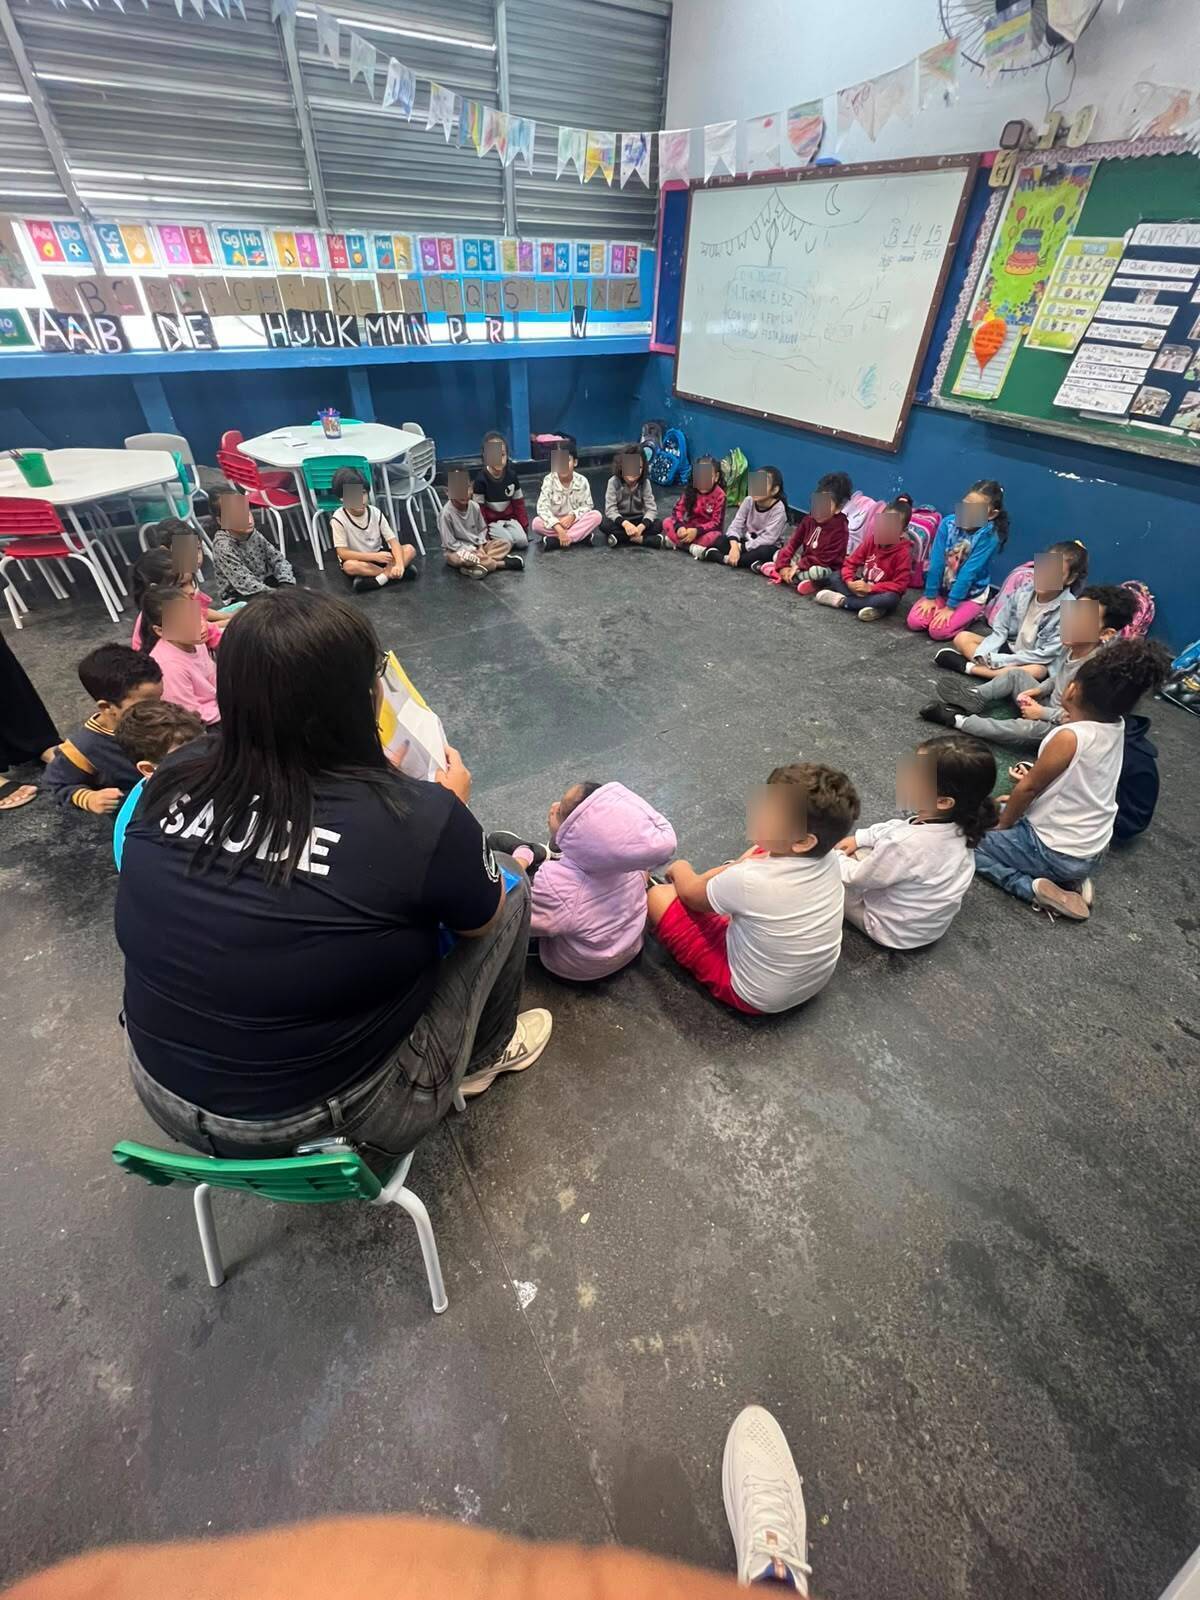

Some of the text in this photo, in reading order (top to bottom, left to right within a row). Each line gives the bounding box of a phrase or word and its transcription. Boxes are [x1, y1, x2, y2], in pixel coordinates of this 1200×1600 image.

[59, 224, 80, 240] Bb
[100, 227, 120, 241] Cc
[221, 232, 241, 249] Gg
[245, 232, 262, 247] Hh
[78, 280, 106, 313] B
[232, 281, 253, 311] G
[333, 282, 350, 311] K
[380, 280, 400, 304] M
[466, 284, 481, 307] Q
[502, 280, 520, 310] S
[554, 281, 569, 309] V
[625, 283, 638, 304] Z
[39, 308, 73, 350] A
[67, 316, 97, 350] A
[94, 317, 123, 353] B
[156, 313, 183, 352] D
[184, 315, 212, 349] E
[265, 312, 289, 347] H
[293, 311, 310, 344] J
[335, 314, 358, 348] K
[365, 316, 388, 346] M
[386, 314, 408, 346] M
[409, 313, 432, 345] N
[448, 317, 463, 344] P
[485, 317, 502, 343] R
[571, 308, 588, 338] W
[159, 793, 341, 877] SAÚDE
